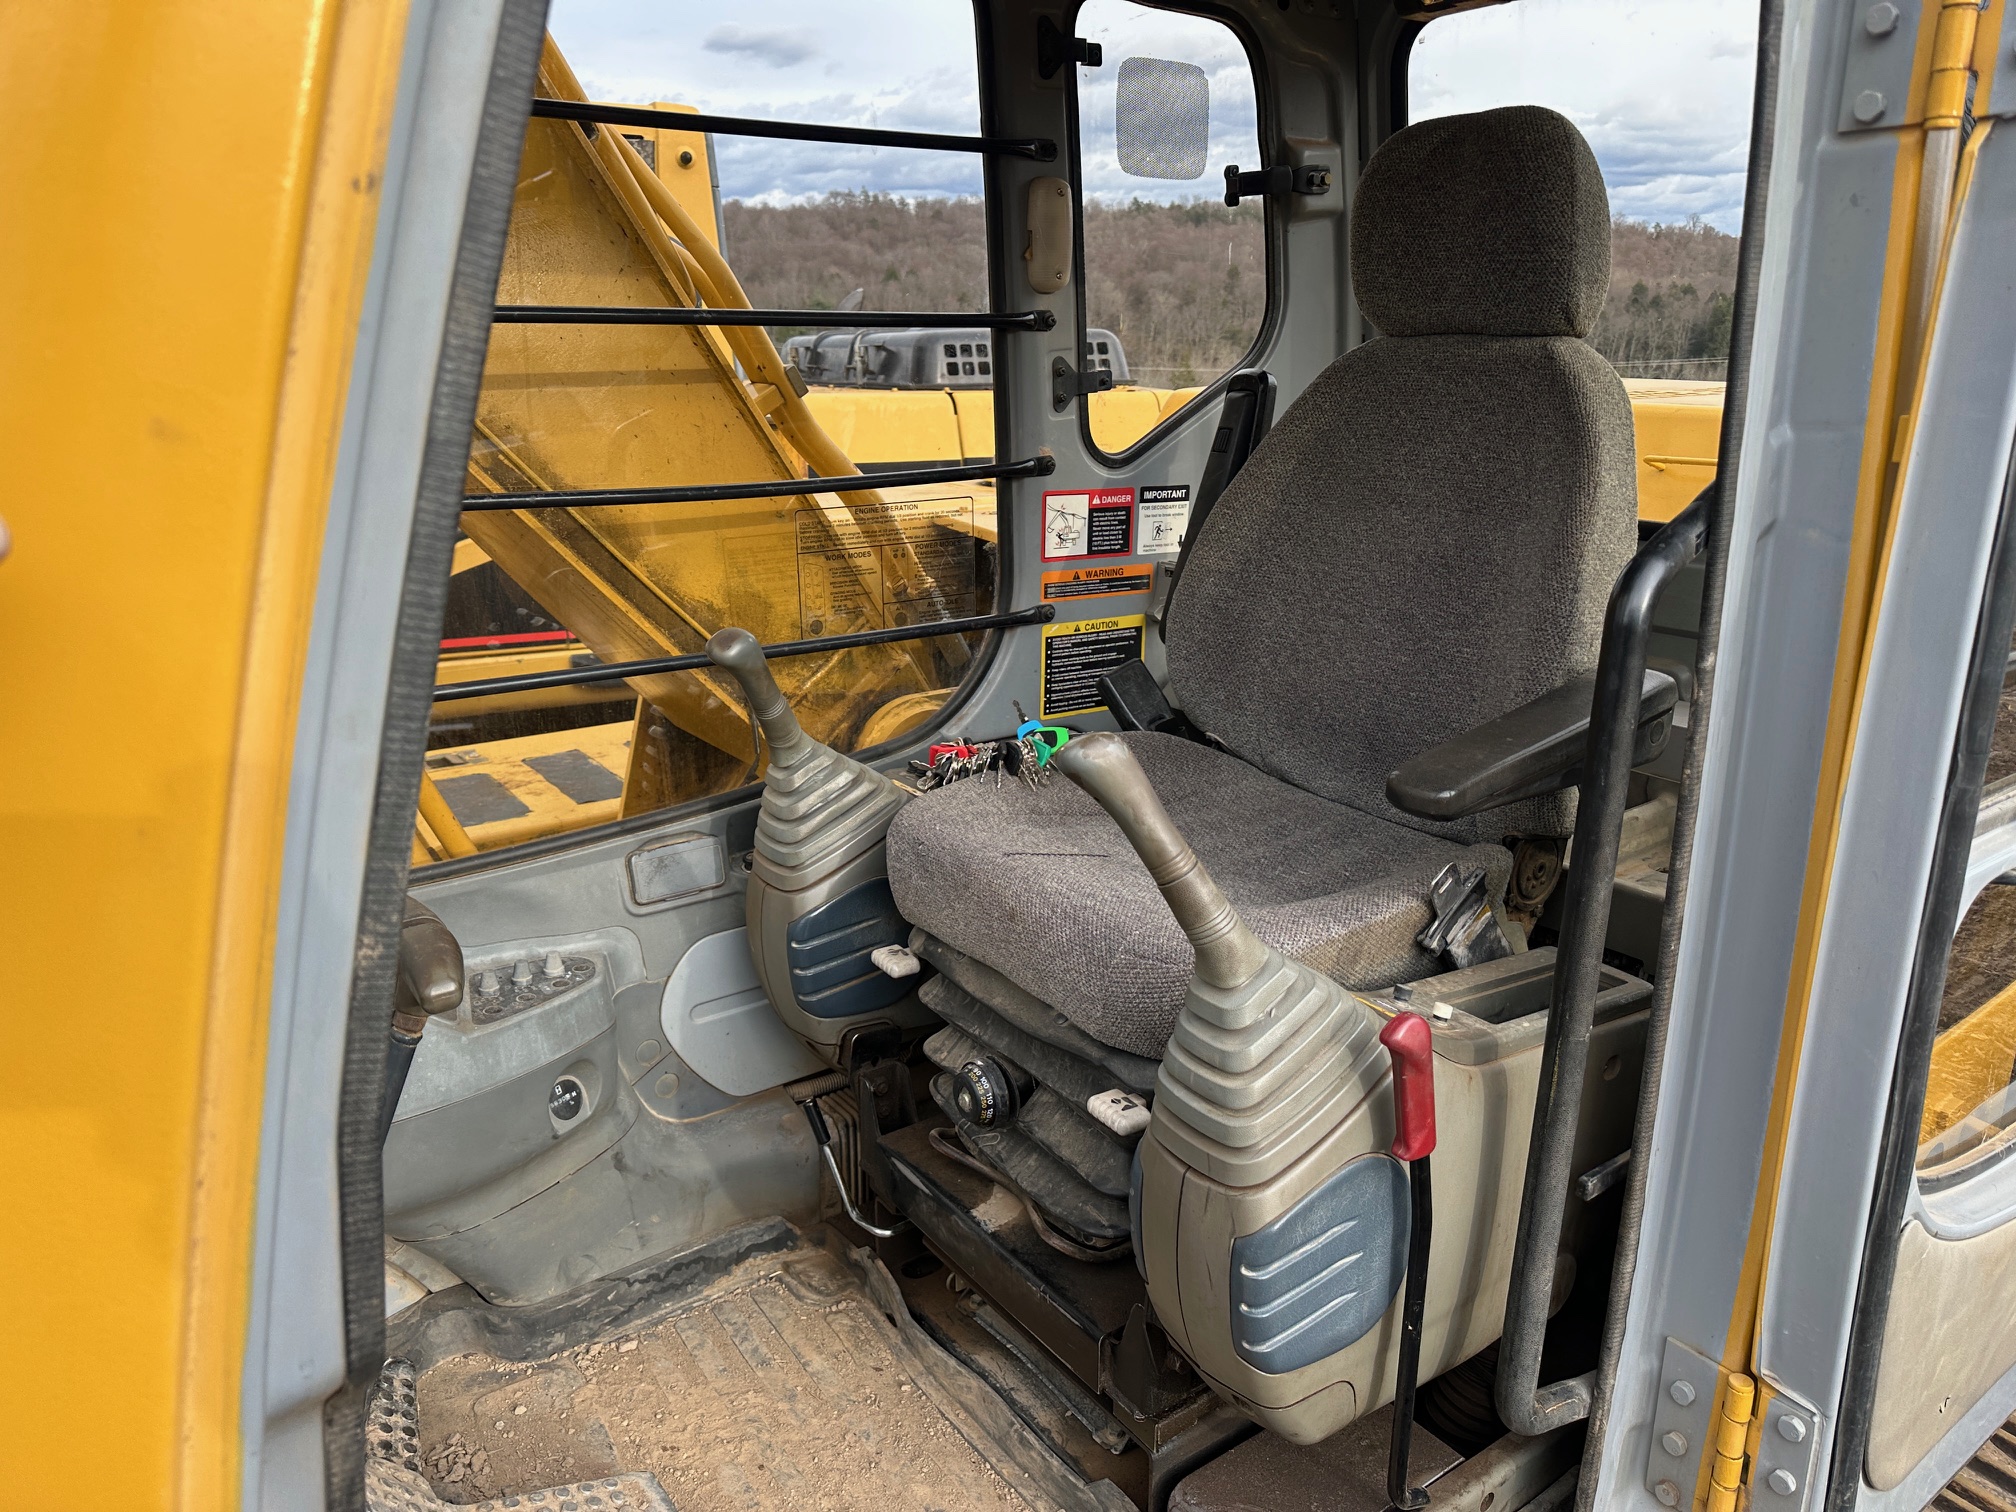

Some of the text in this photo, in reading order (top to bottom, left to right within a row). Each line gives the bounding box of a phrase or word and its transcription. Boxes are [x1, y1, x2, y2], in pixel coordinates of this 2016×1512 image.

[1144, 490, 1186, 499] IMPORTANT
[1102, 495, 1131, 503] DANGER
[881, 504, 918, 512] OPERATION
[915, 542, 938, 550] POWER
[848, 551, 872, 559] MODES
[1086, 568, 1124, 578] WARNING
[1084, 620, 1118, 631] CAUTION
[980, 1077, 989, 1088] 100
